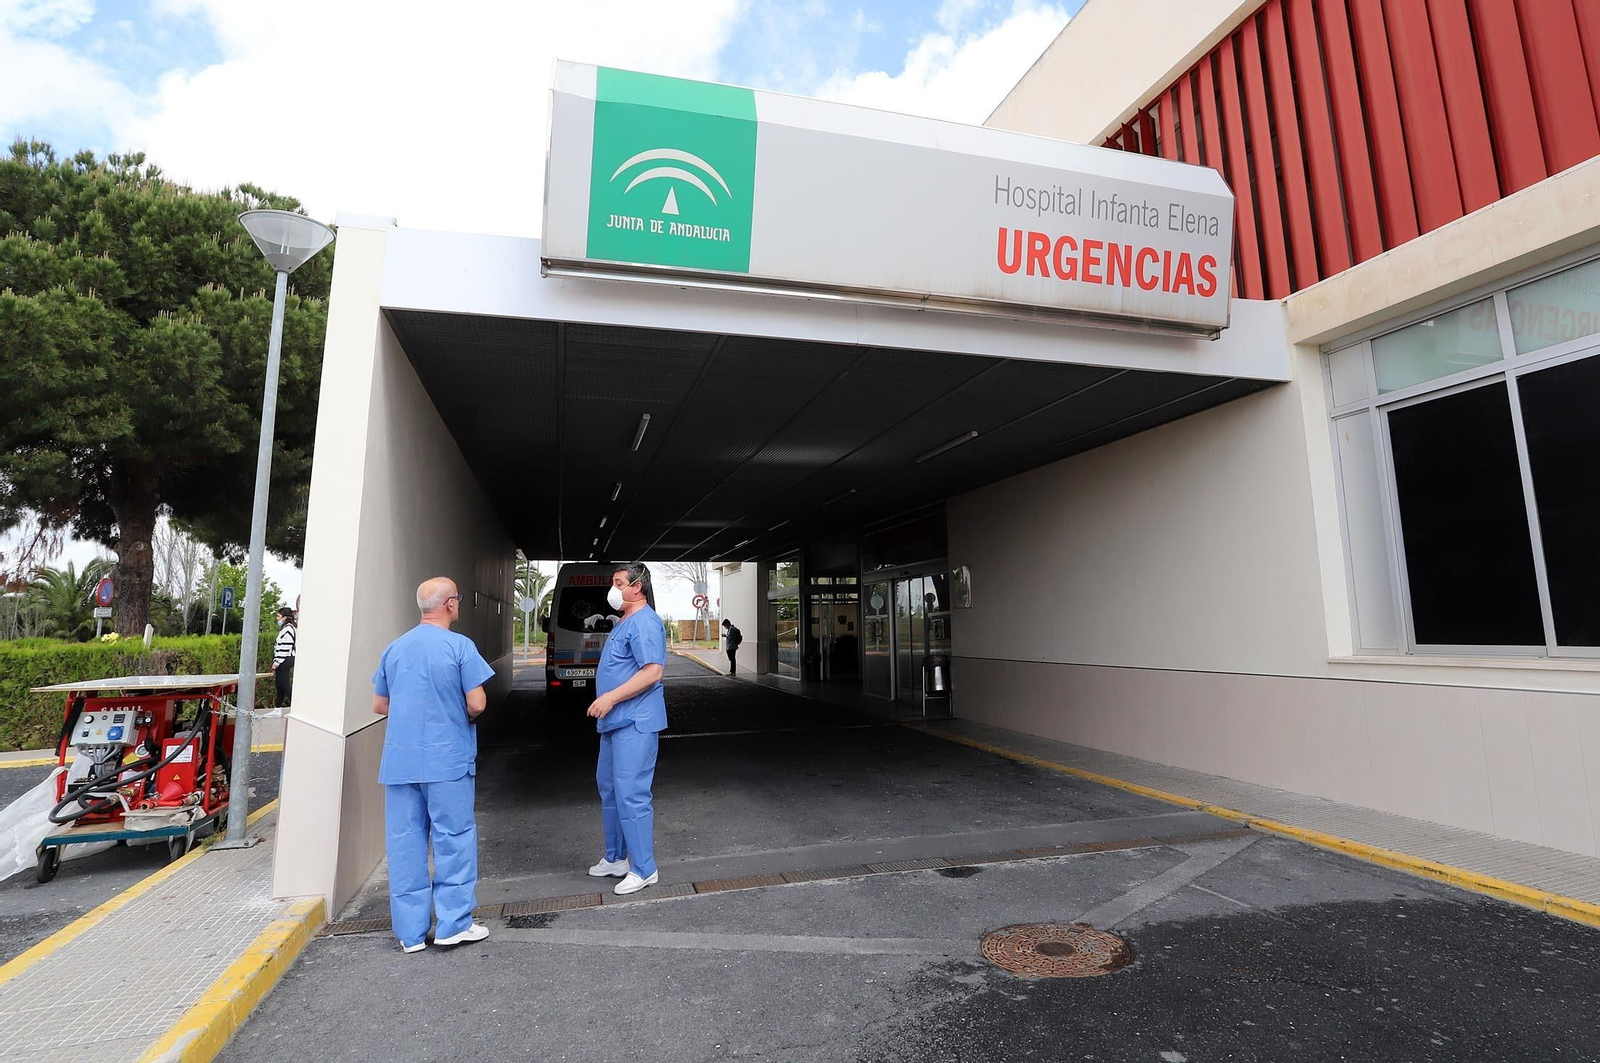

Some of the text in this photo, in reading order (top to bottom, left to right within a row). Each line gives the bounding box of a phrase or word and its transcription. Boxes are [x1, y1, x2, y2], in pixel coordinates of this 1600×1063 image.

[606, 214, 731, 242] JUNTA DE ANDALUCIA
[994, 175, 1219, 237] Hospital Infanta Elena
[997, 226, 1218, 298] URGENCIAS
